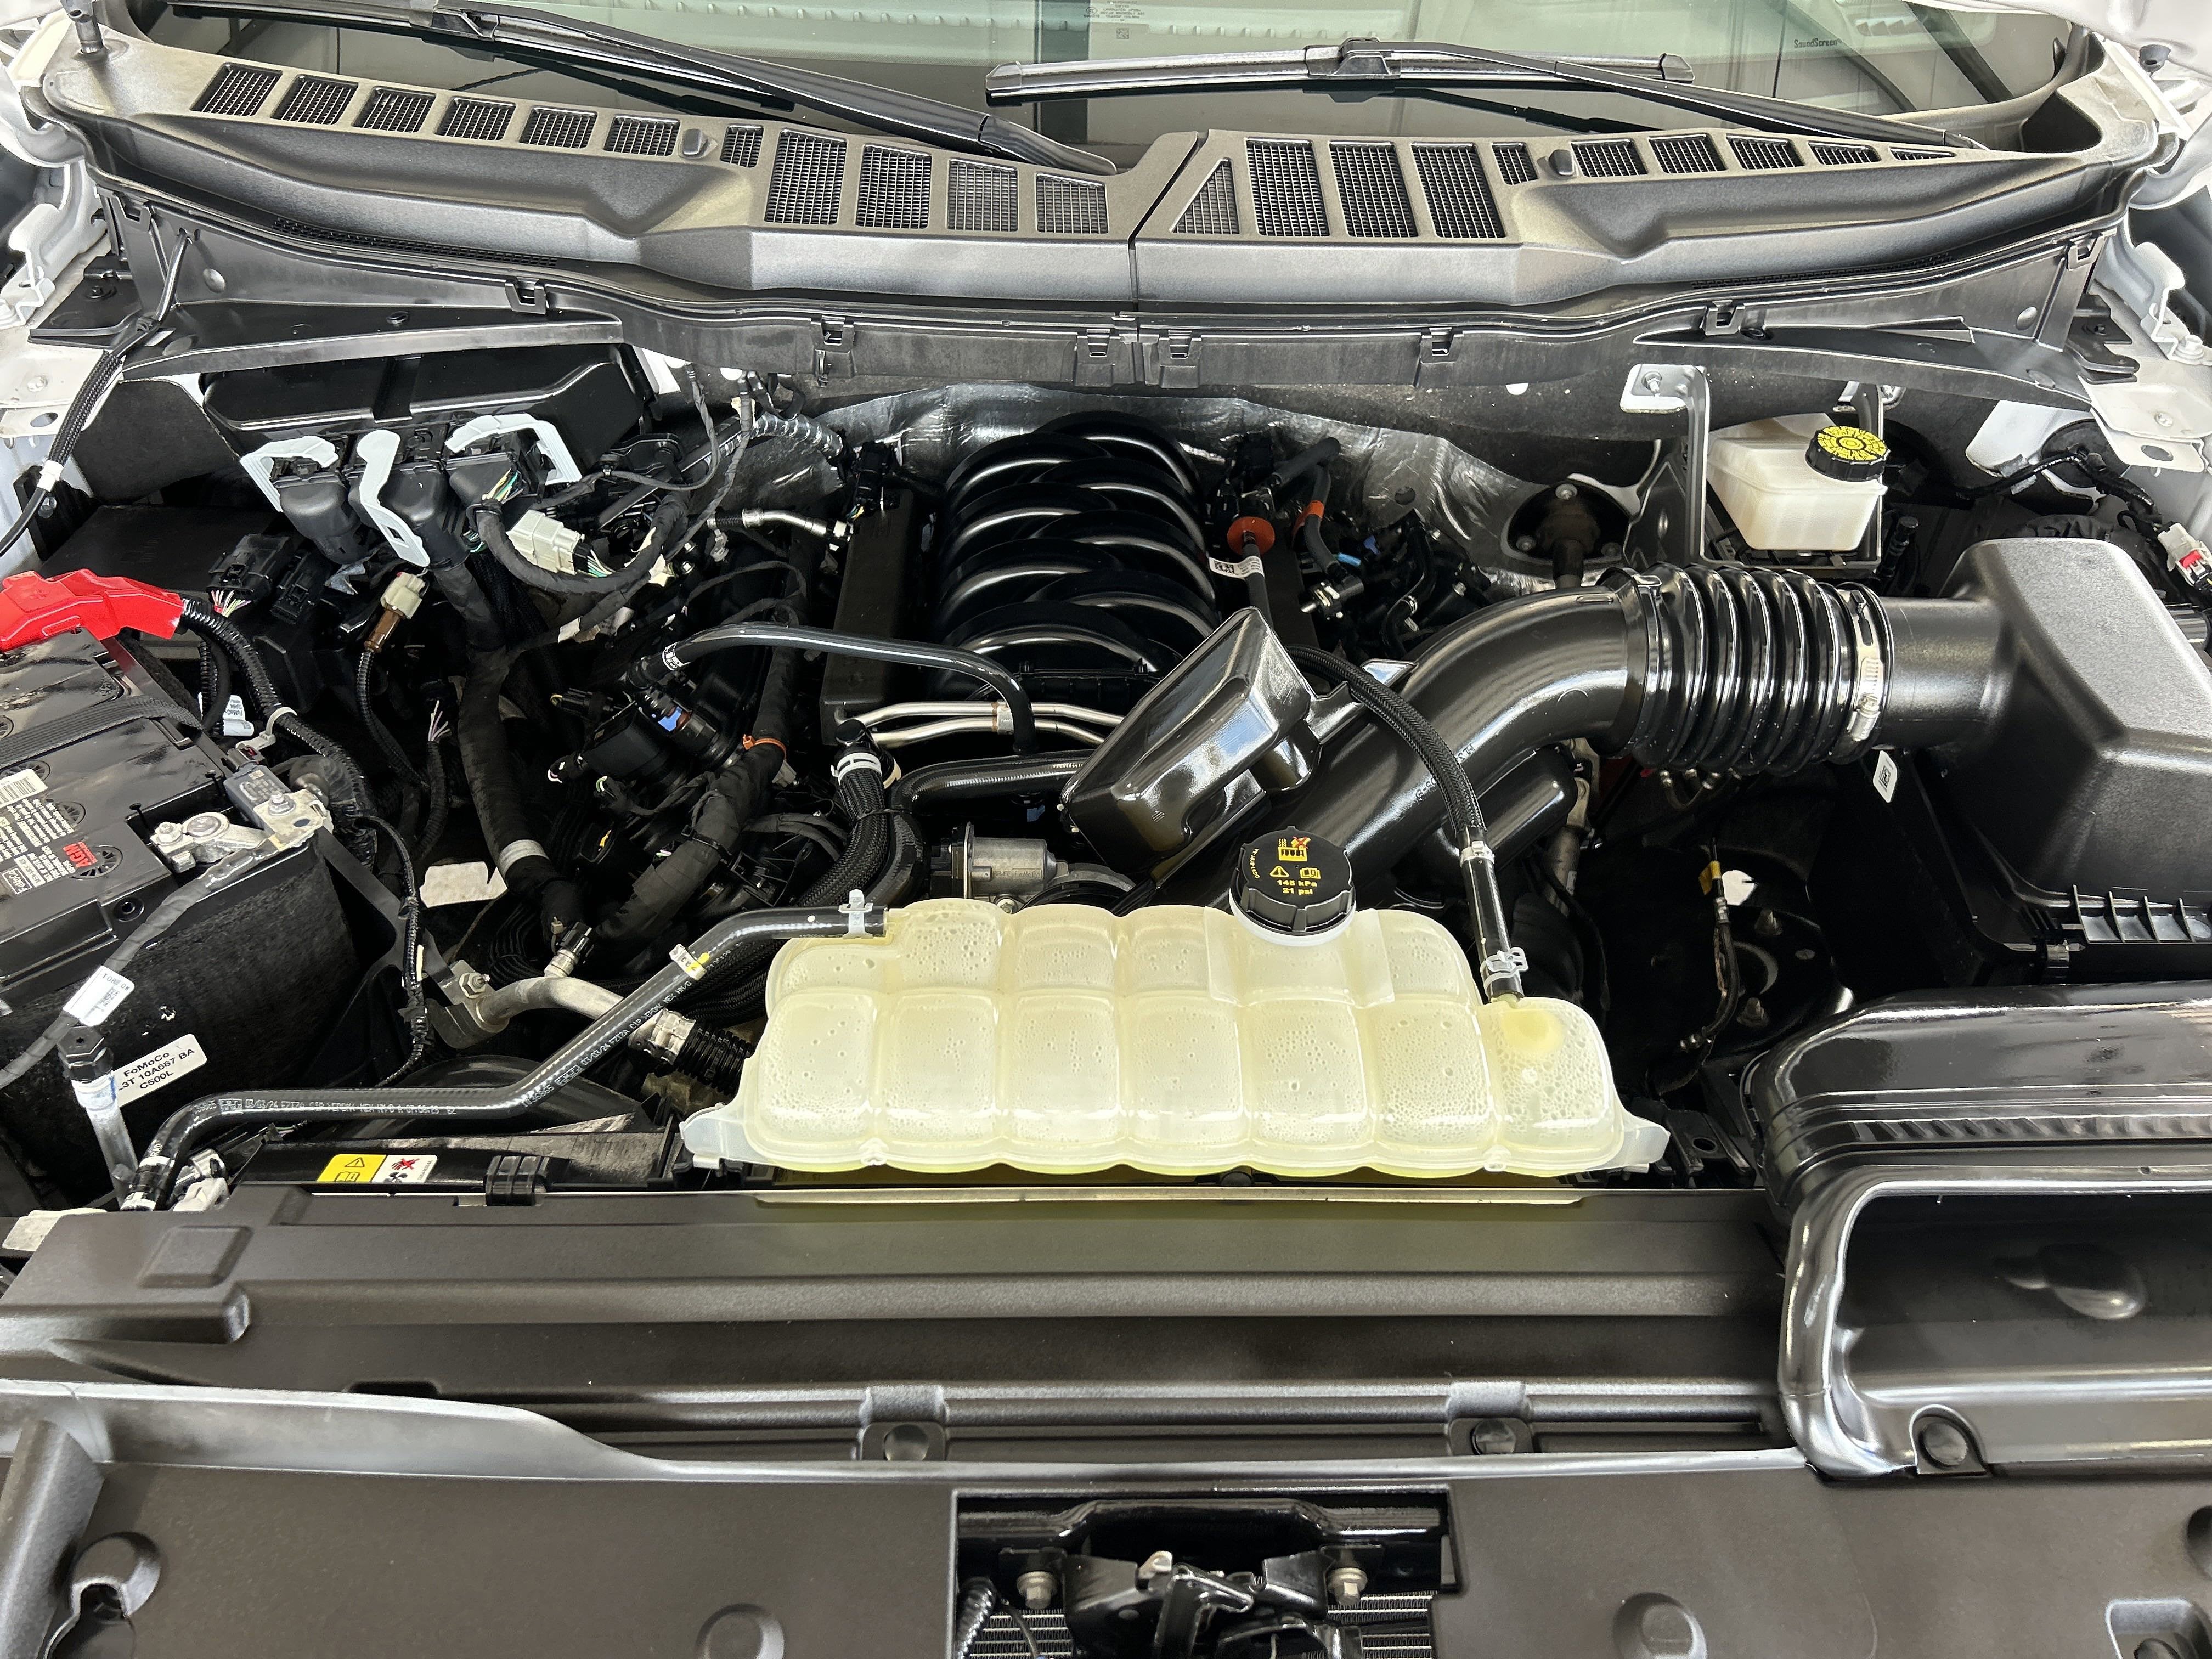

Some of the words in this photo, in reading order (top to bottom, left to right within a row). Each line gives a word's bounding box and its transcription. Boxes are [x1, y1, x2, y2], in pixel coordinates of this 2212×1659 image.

[63, 842, 92, 868] AGM
[1297, 887, 1313, 895] psi
[1298, 879, 1318, 888] kPa
[120, 982, 130, 991] OK
[581, 1043, 610, 1065] 03/03/24
[663, 993, 675, 1004] MEX
[118, 1077, 136, 1091] 3T
[138, 1057, 176, 1079] 10A687
[178, 1048, 195, 1059] BA
[123, 1052, 170, 1077] FoMoCo
[140, 1070, 174, 1089] C500L
